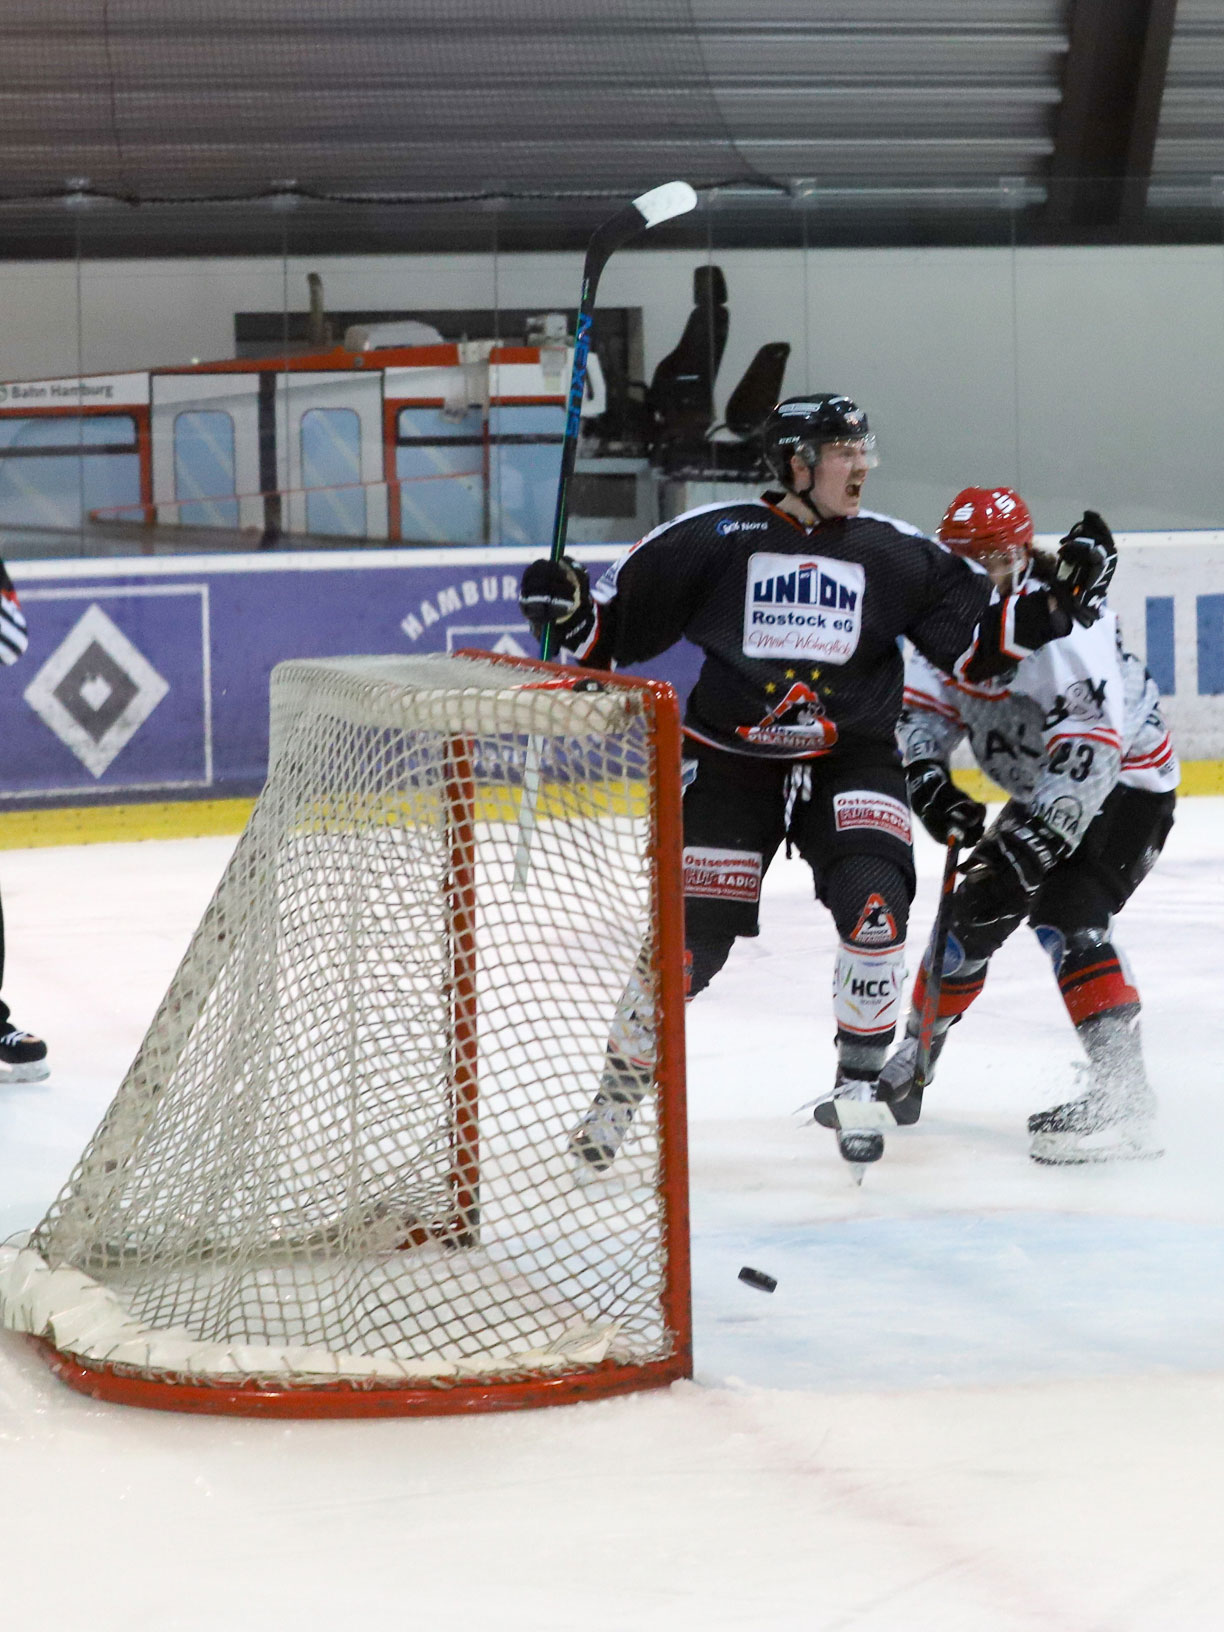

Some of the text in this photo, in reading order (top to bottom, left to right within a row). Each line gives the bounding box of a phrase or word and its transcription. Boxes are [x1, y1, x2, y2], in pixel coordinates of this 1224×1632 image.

[50, 385, 113, 398] Hamburg
[753, 563, 857, 612] UNION
[401, 575, 520, 641] HAMBUR
[752, 610, 826, 629] Rostock
[1049, 741, 1094, 783] 23
[851, 978, 891, 998] HCC
